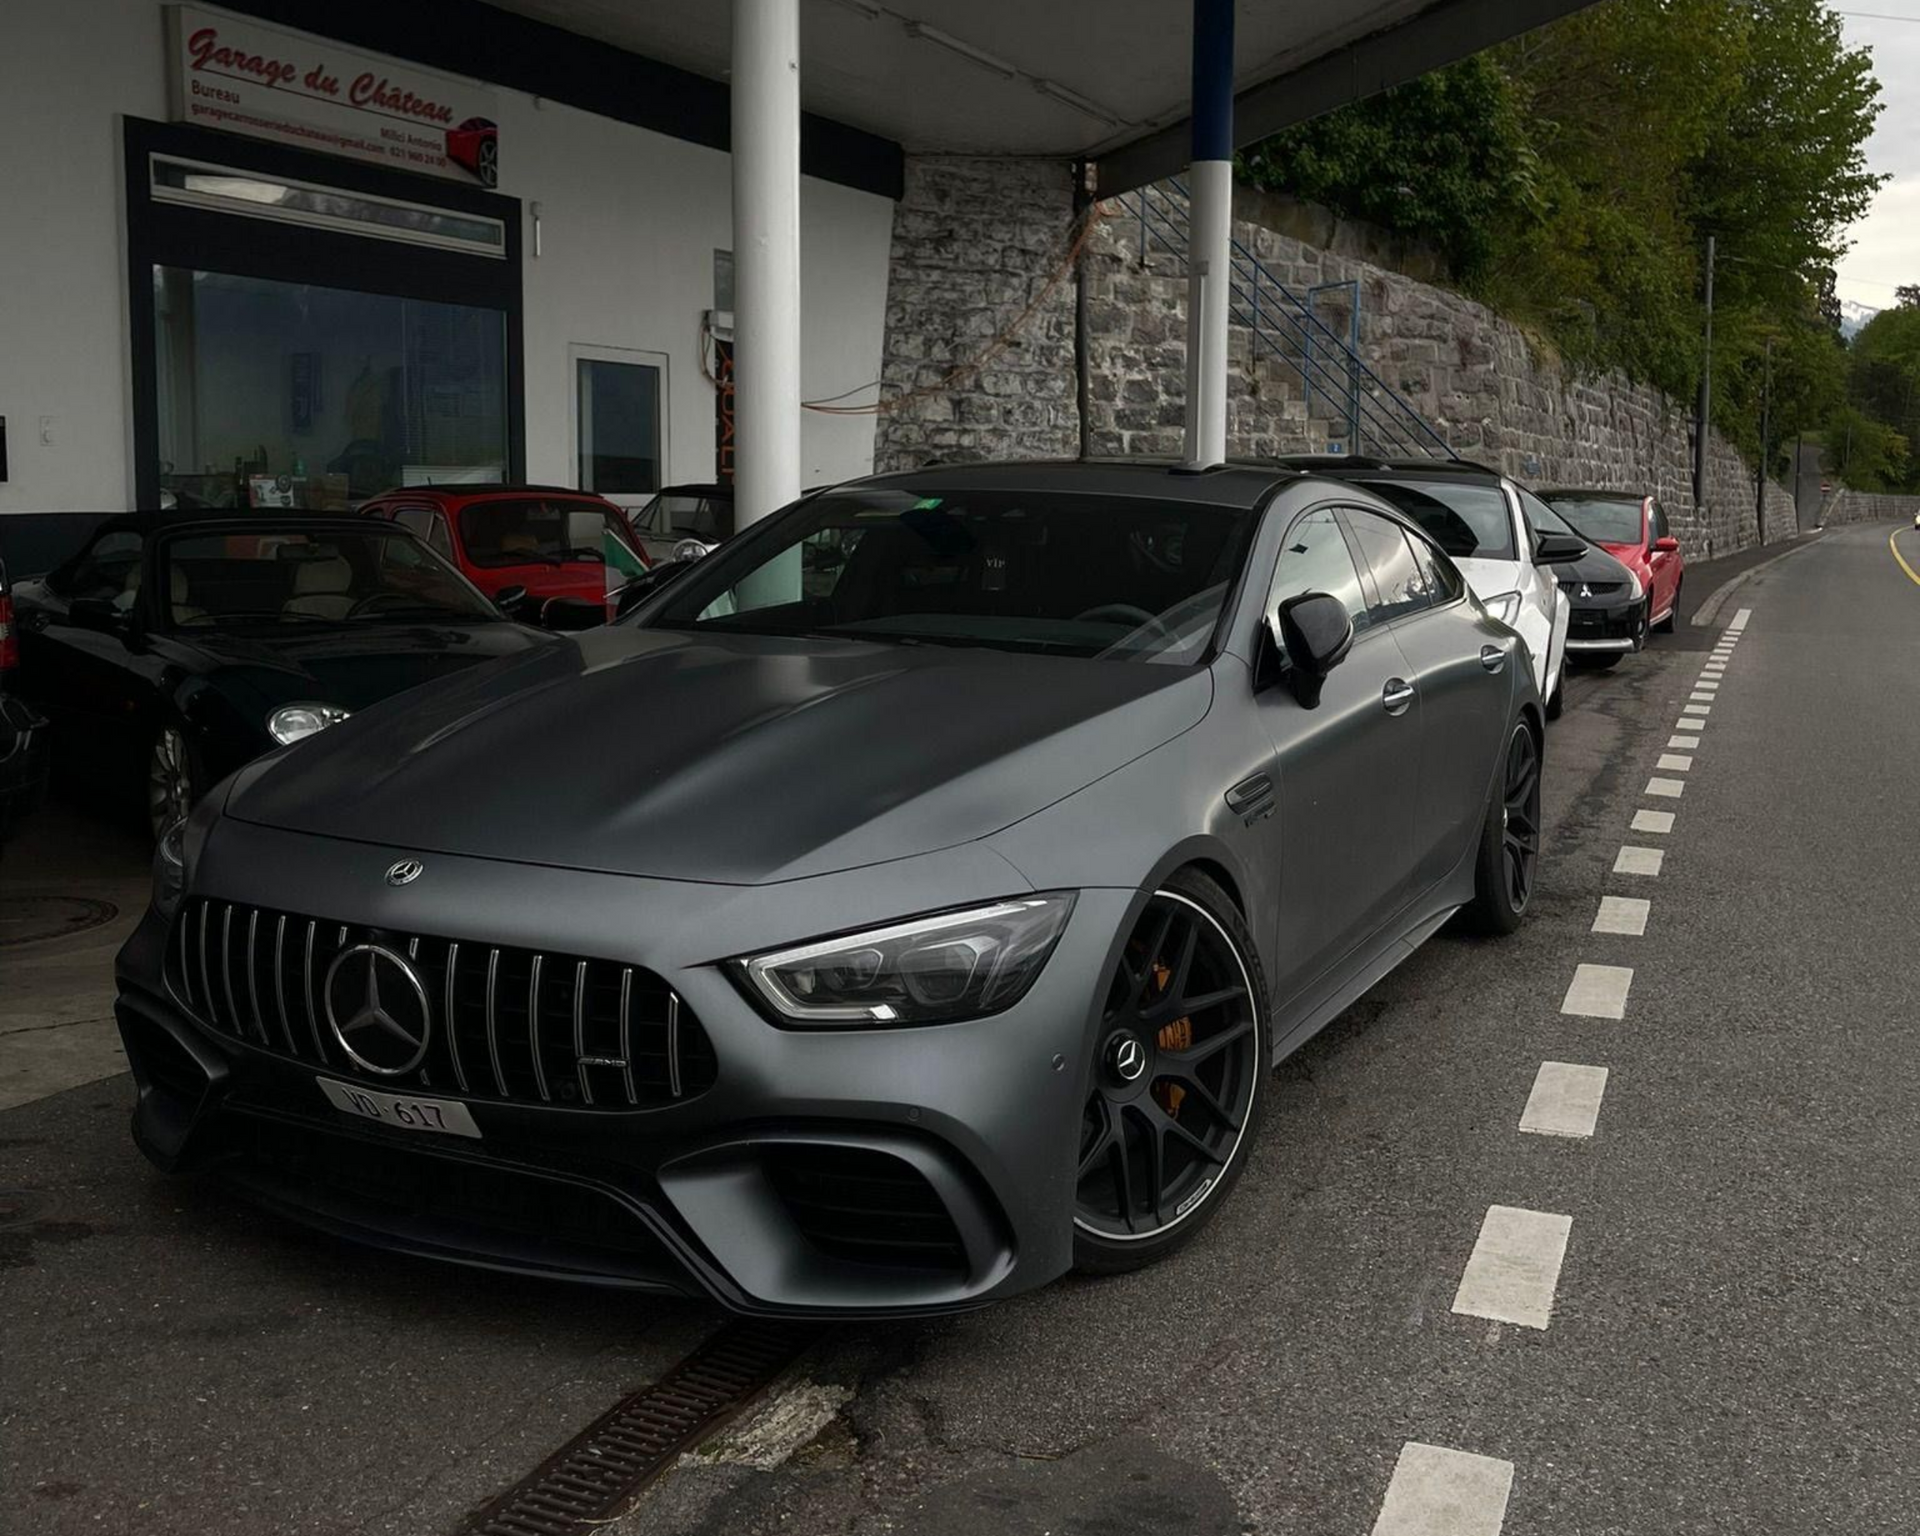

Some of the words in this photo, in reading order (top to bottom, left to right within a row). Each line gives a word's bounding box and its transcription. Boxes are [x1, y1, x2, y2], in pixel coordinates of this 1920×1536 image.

[188, 28, 296, 88] Garage
[304, 63, 341, 96] du
[349, 72, 454, 123] Château
[191, 79, 240, 104] Bureau
[408, 134, 442, 152] Antonio
[341, 1087, 382, 1117] VD
[394, 1101, 448, 1130] 617
